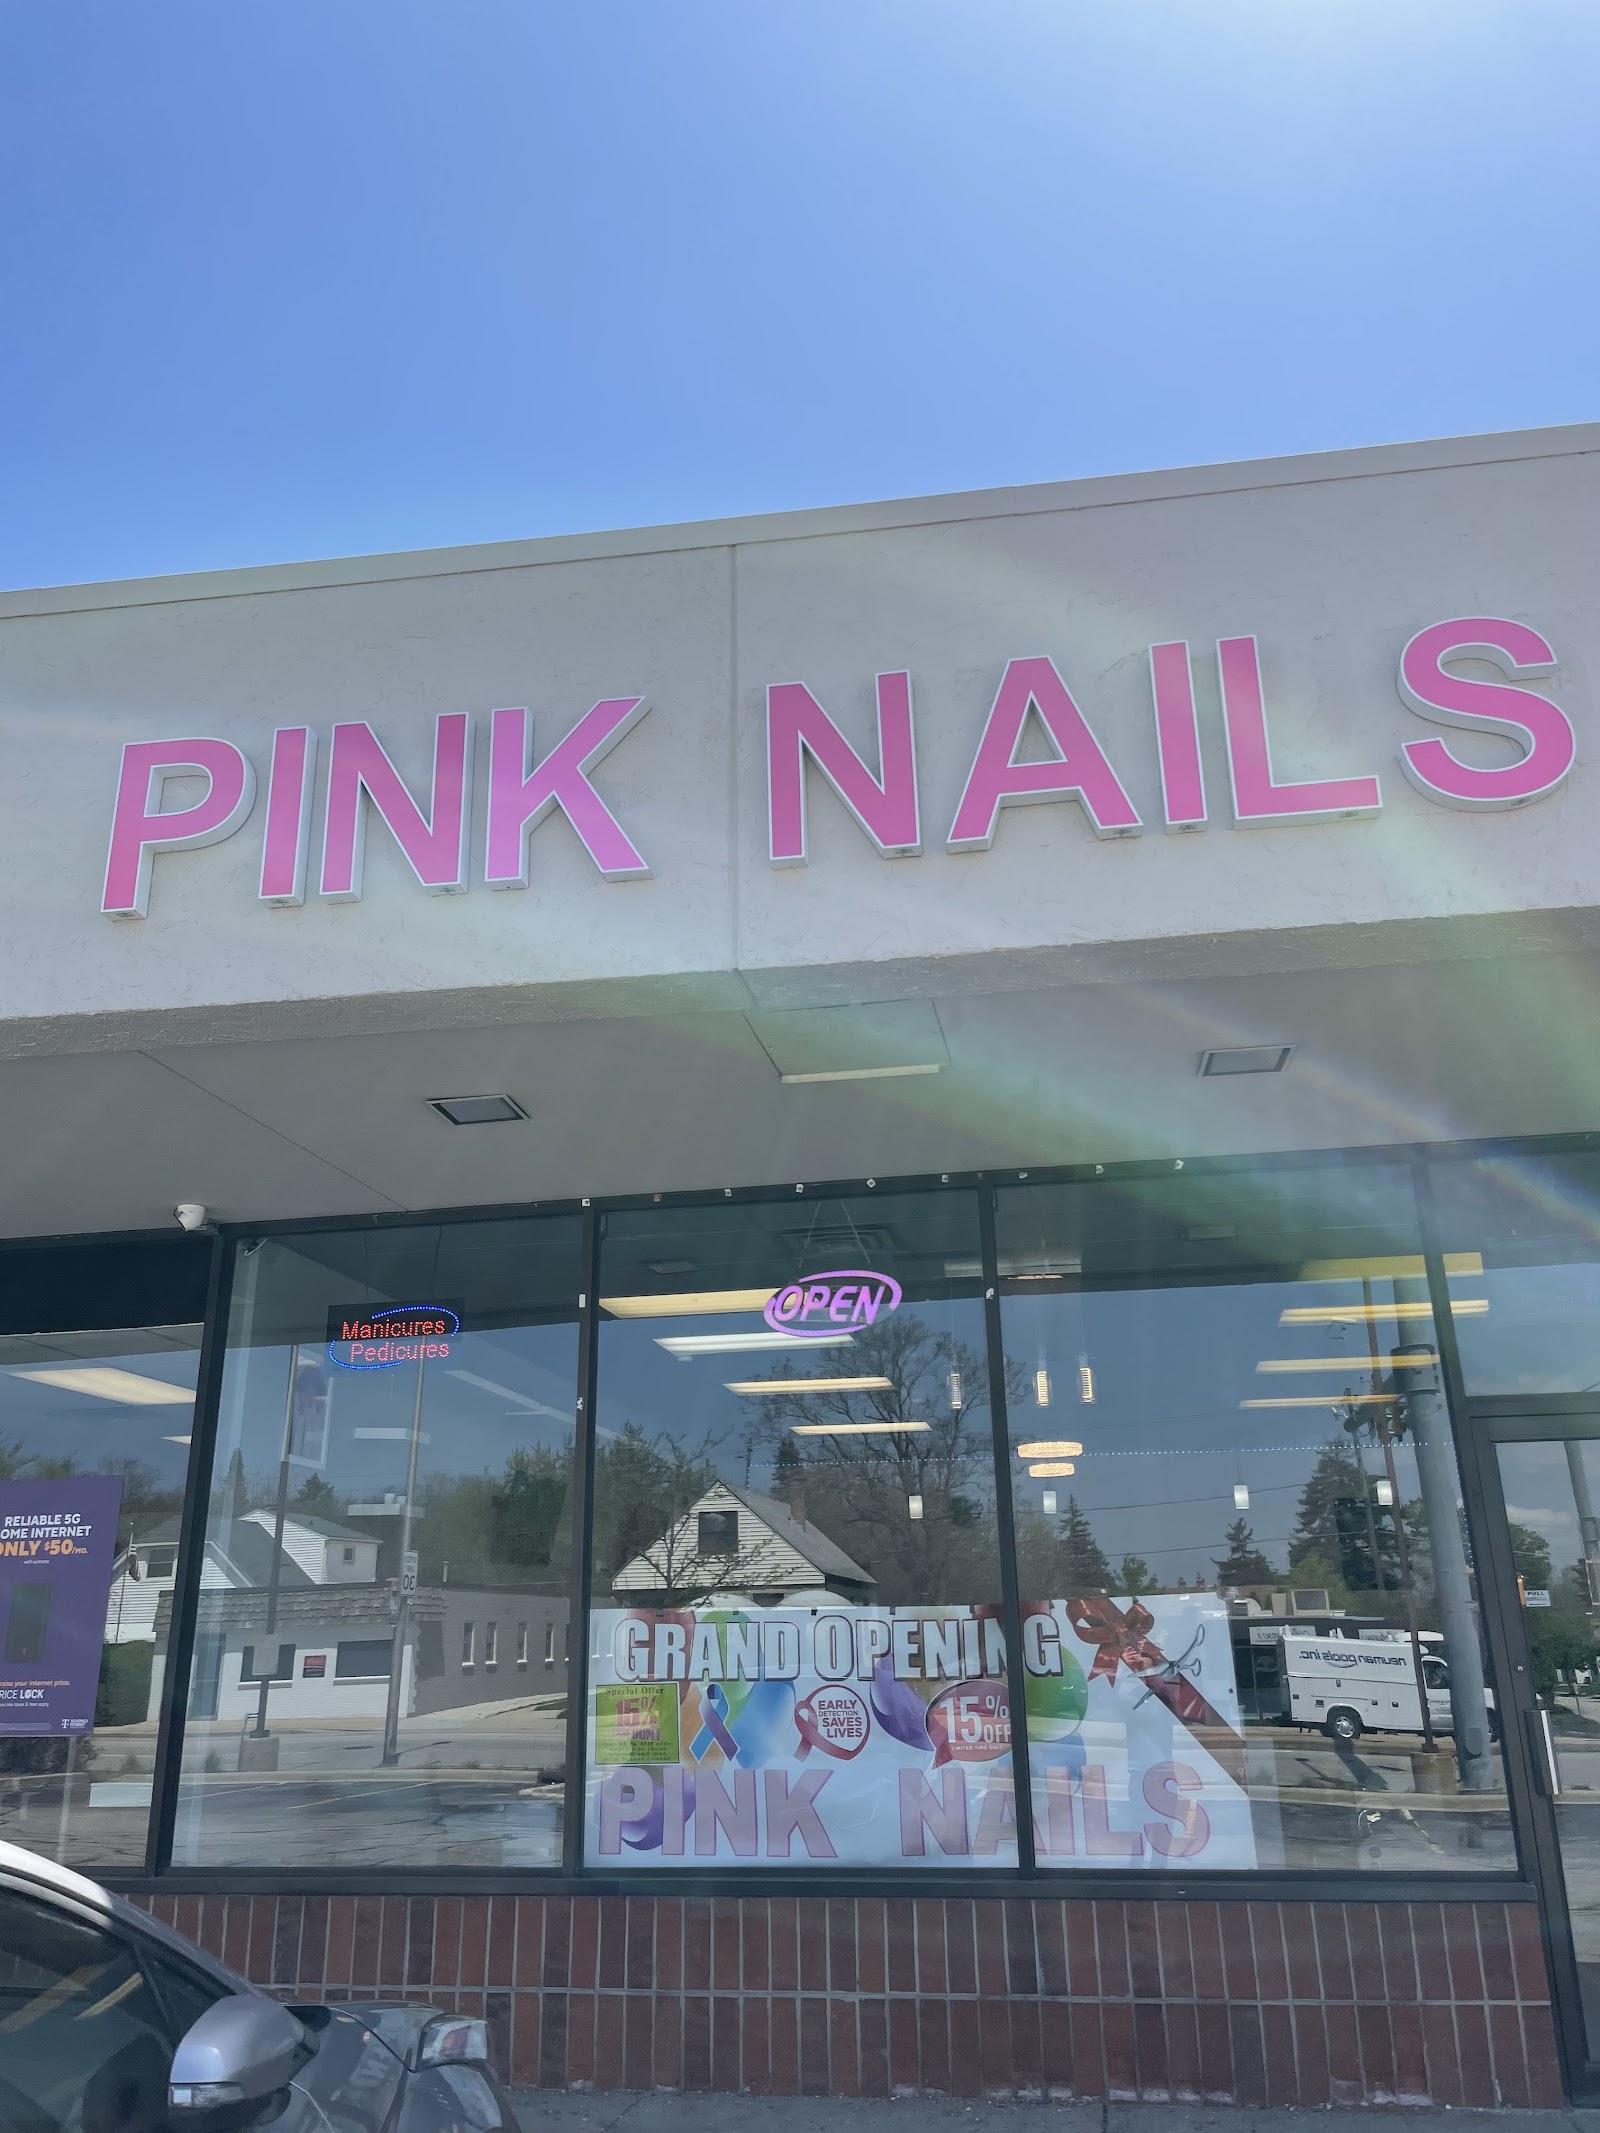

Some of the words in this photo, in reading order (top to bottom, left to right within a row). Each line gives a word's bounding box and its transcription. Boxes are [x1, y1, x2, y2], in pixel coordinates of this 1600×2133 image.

[101, 695, 653, 922] PINK
[765, 616, 1577, 870] NAILS
[774, 1285, 886, 1325] OPEN
[341, 1319, 446, 1340] Manicures
[350, 1341, 450, 1363] Pedicures
[4, 1514, 63, 1527] RELIABLE
[64, 1513, 81, 1525] 5G
[0, 1528, 29, 1540] OME
[30, 1525, 92, 1539] INTERNET
[614, 1617, 801, 1683] GRAND
[813, 1613, 1064, 1682] OPENING
[0, 1689, 18, 1700] RICE
[20, 1688, 45, 1699] LOCK
[53, 1679, 71, 1688] price.
[606, 1687, 638, 1696] Special
[641, 1686, 665, 1695] Offer
[615, 1695, 657, 1727] 15%
[818, 1699, 858, 1710] EARLY
[822, 1717, 863, 1728] SAVES
[940, 1694, 1009, 1743] 15%
[826, 1728, 863, 1739] LIVES
[983, 1723, 1012, 1744] OFF
[598, 1766, 838, 1859] PINK
[898, 1761, 1211, 1858] NAILS
